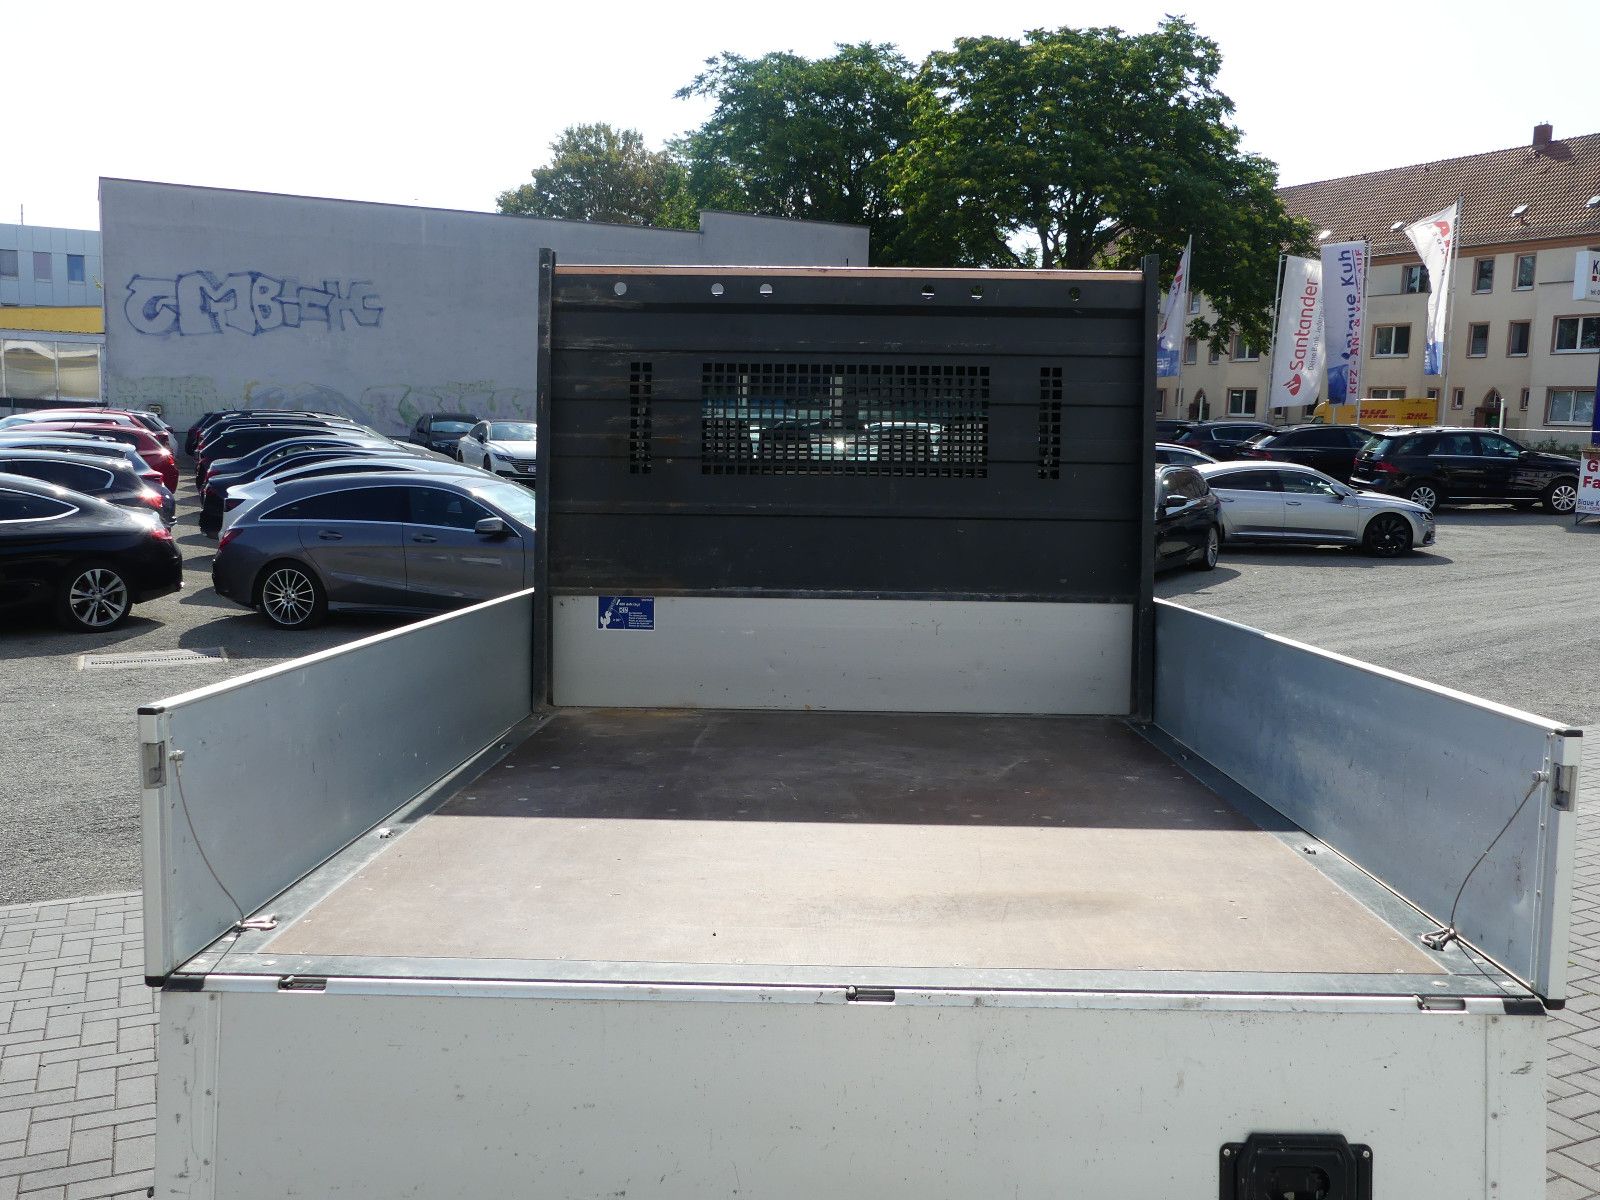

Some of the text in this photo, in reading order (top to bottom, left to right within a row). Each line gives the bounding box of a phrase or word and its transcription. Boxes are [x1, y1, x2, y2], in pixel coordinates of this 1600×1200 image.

[1338, 249, 1355, 287] Kuh
[1289, 278, 1319, 372] Santander
[1350, 369, 1358, 395] KFZ
[1359, 409, 1388, 418] DHL
[1406, 412, 1428, 420] DHL
